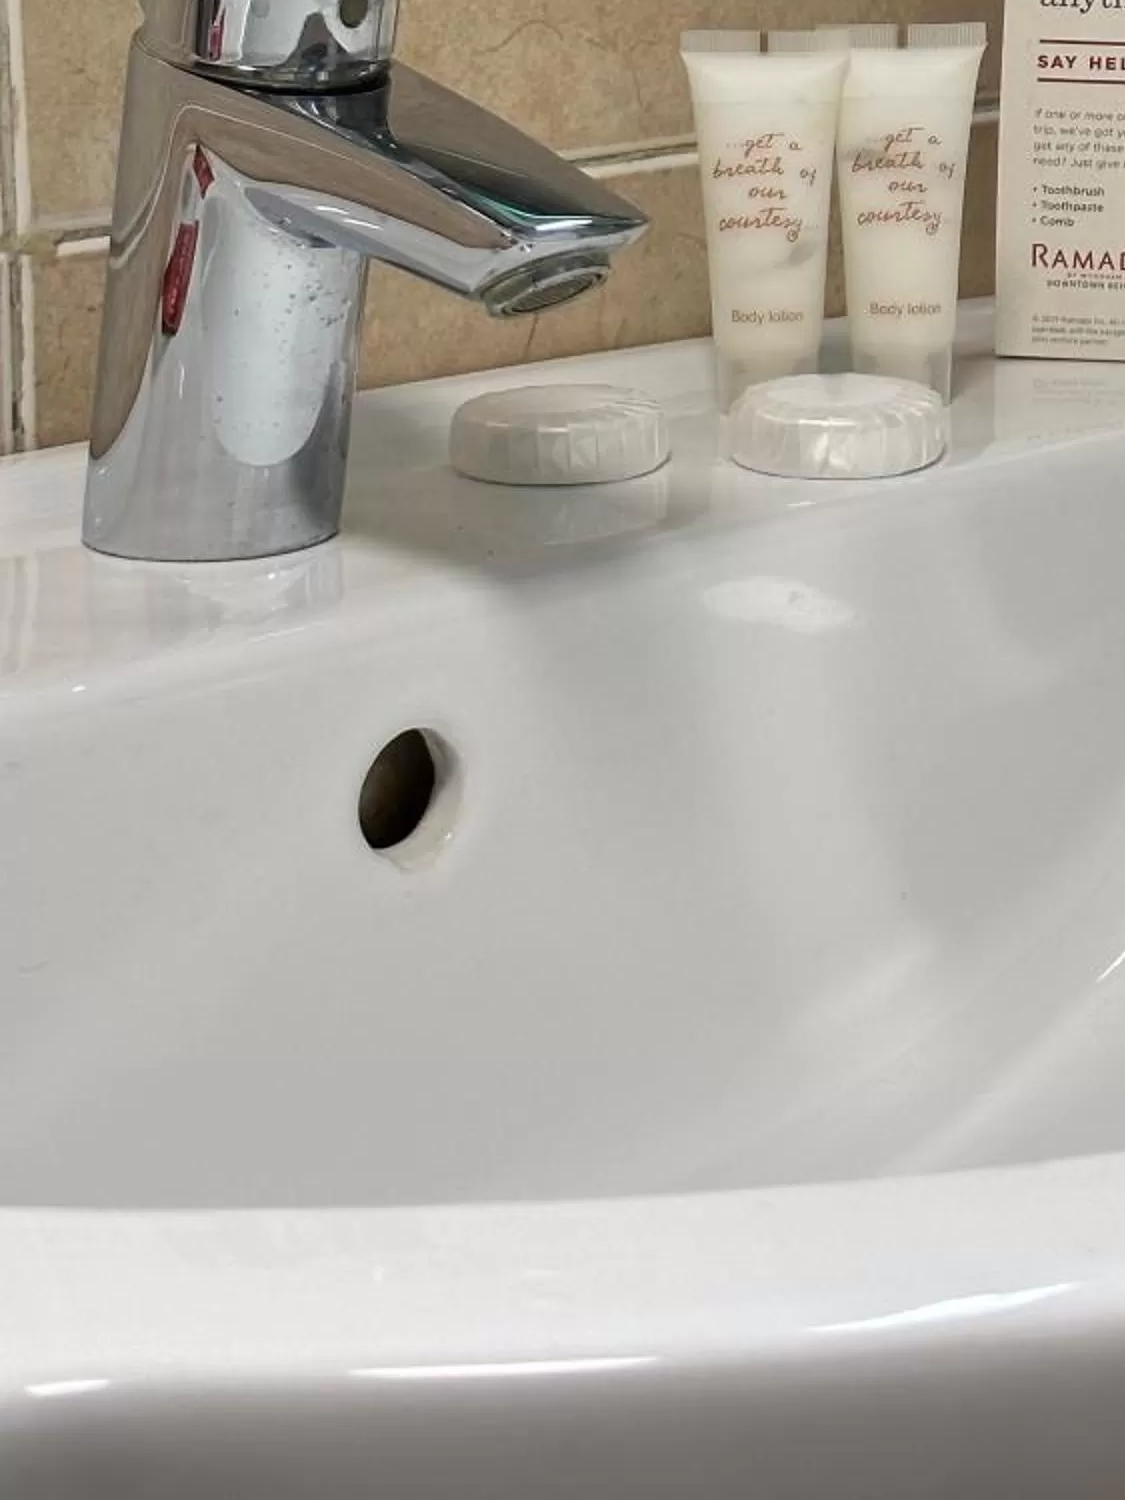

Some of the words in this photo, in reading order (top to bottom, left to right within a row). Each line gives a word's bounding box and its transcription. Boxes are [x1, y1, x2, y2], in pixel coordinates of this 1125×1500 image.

[1037, 56, 1076, 69] SAY
[789, 141, 802, 151] a
[927, 135, 942, 145] a
[712, 156, 784, 178] breath
[800, 168, 816, 187] of
[851, 151, 925, 172] breath
[939, 162, 955, 180] of
[748, 186, 787, 199] our
[887, 180, 928, 193] our
[1042, 185, 1104, 196] Toothbrush
[1041, 201, 1104, 213] Toothpaste
[719, 207, 802, 240] courtesy
[857, 200, 942, 234] courtesy
[1040, 215, 1074, 226] Comb
[869, 302, 902, 317] Body
[907, 303, 941, 316] lotion
[731, 309, 764, 324] Body
[768, 309, 804, 323] lotion
